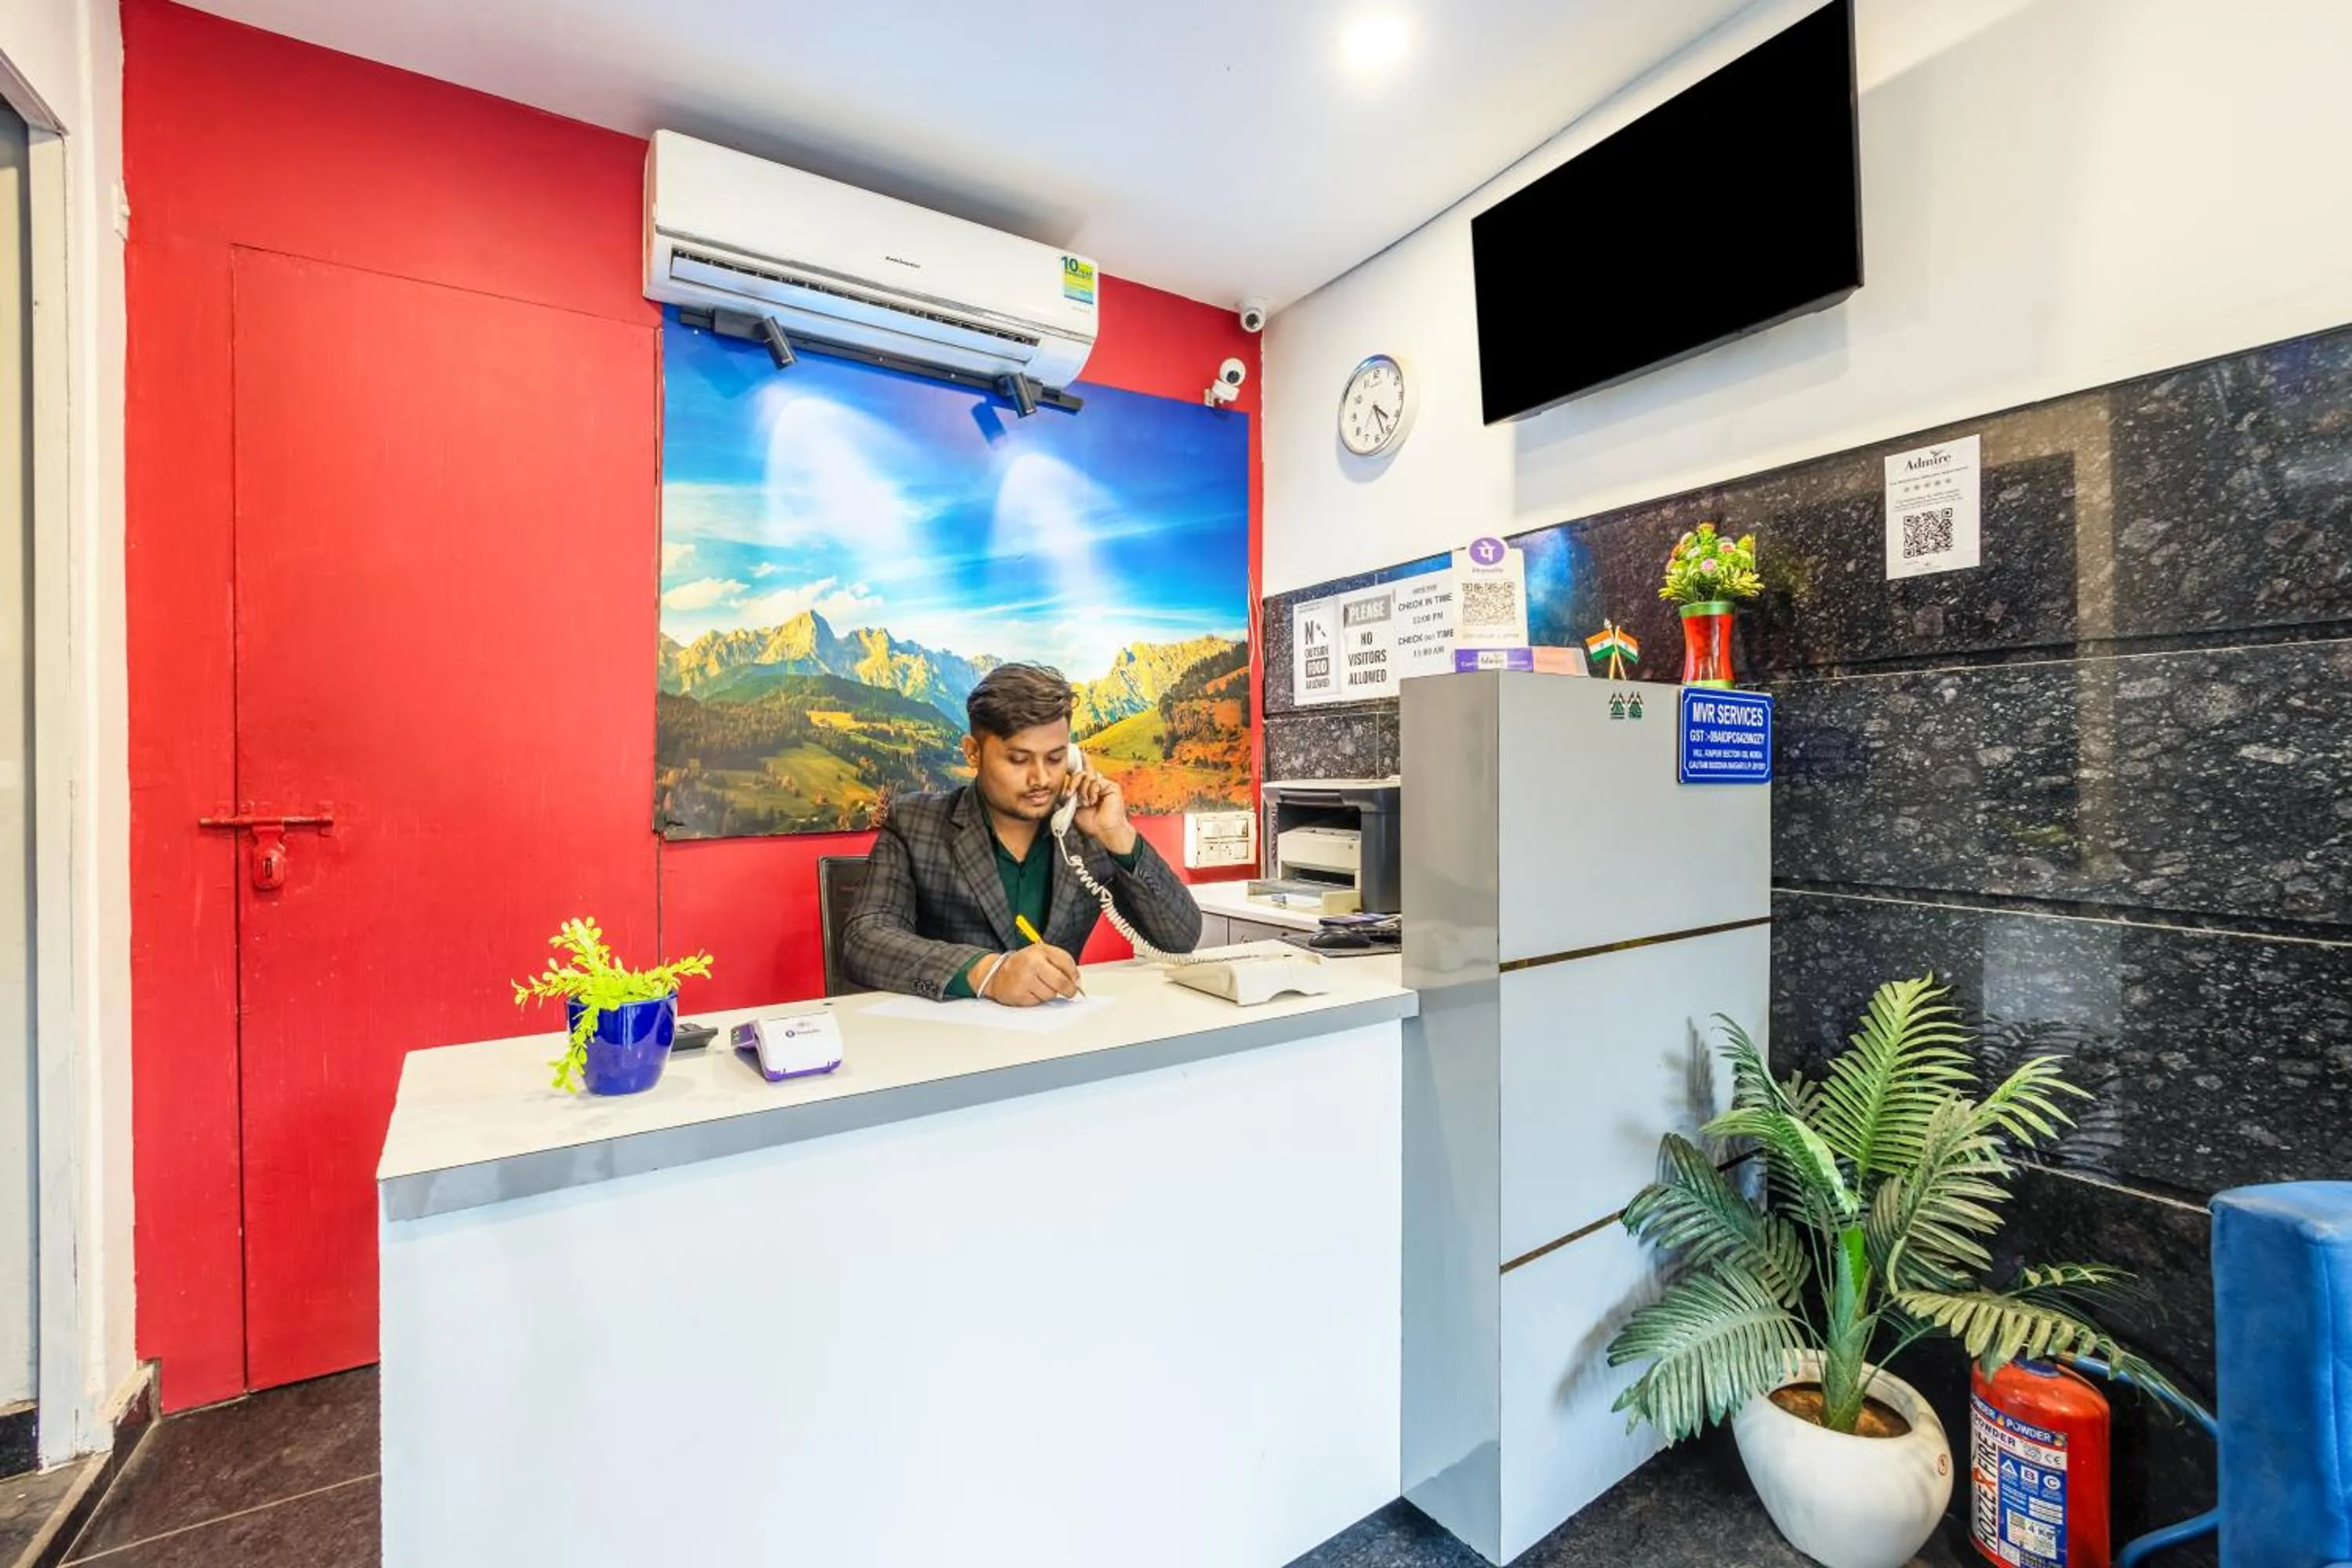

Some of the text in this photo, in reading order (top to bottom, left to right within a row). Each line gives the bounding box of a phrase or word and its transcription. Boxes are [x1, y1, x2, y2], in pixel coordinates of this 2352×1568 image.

[1061, 256, 1079, 273] 10
[1904, 454, 1952, 471] Admire
[1398, 592, 1454, 612] CHECK IN TIME
[1348, 600, 1387, 623] PLEASE
[1360, 631, 1374, 646] NO
[1397, 633, 1423, 646] CHECK
[1436, 628, 1454, 639] TIME
[1348, 648, 1387, 667] VISITORS
[1348, 669, 1387, 685] ALLOWED
[1692, 702, 1764, 727] MVR SERVICES
[1690, 728, 1704, 742] GST
[2006, 1417, 2052, 1443] POWDER
[1978, 1432, 1997, 1478] FIRE
